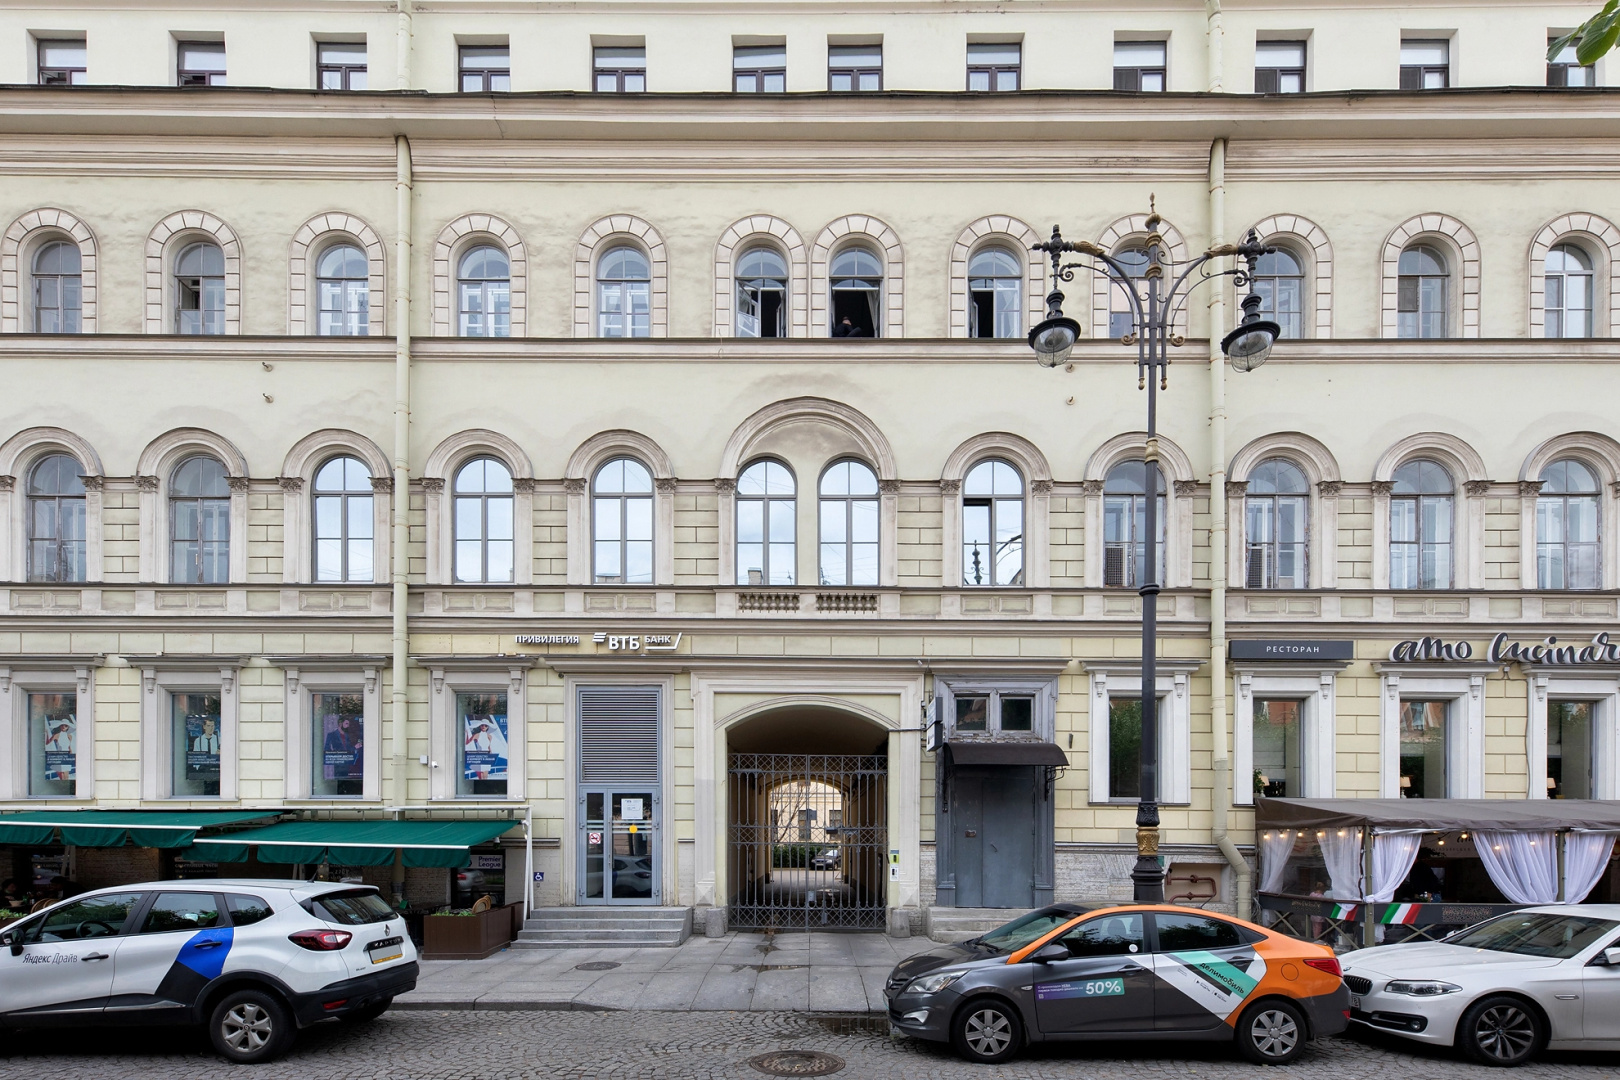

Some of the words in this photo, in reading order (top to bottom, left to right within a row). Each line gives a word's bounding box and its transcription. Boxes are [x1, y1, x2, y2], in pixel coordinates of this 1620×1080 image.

[515, 635, 580, 644] ПРИВИЛЕГИЯ
[608, 635, 640, 650] ВТБ
[645, 635, 672, 644] БАНК
[1266, 645, 1320, 653] РЕСТОРАН
[1389, 636, 1473, 662] amo
[22, 953, 51, 964] Яндекс
[52, 952, 78, 964] Драйв
[1200, 962, 1245, 994] делимобиль
[1085, 980, 1122, 995] 50%
